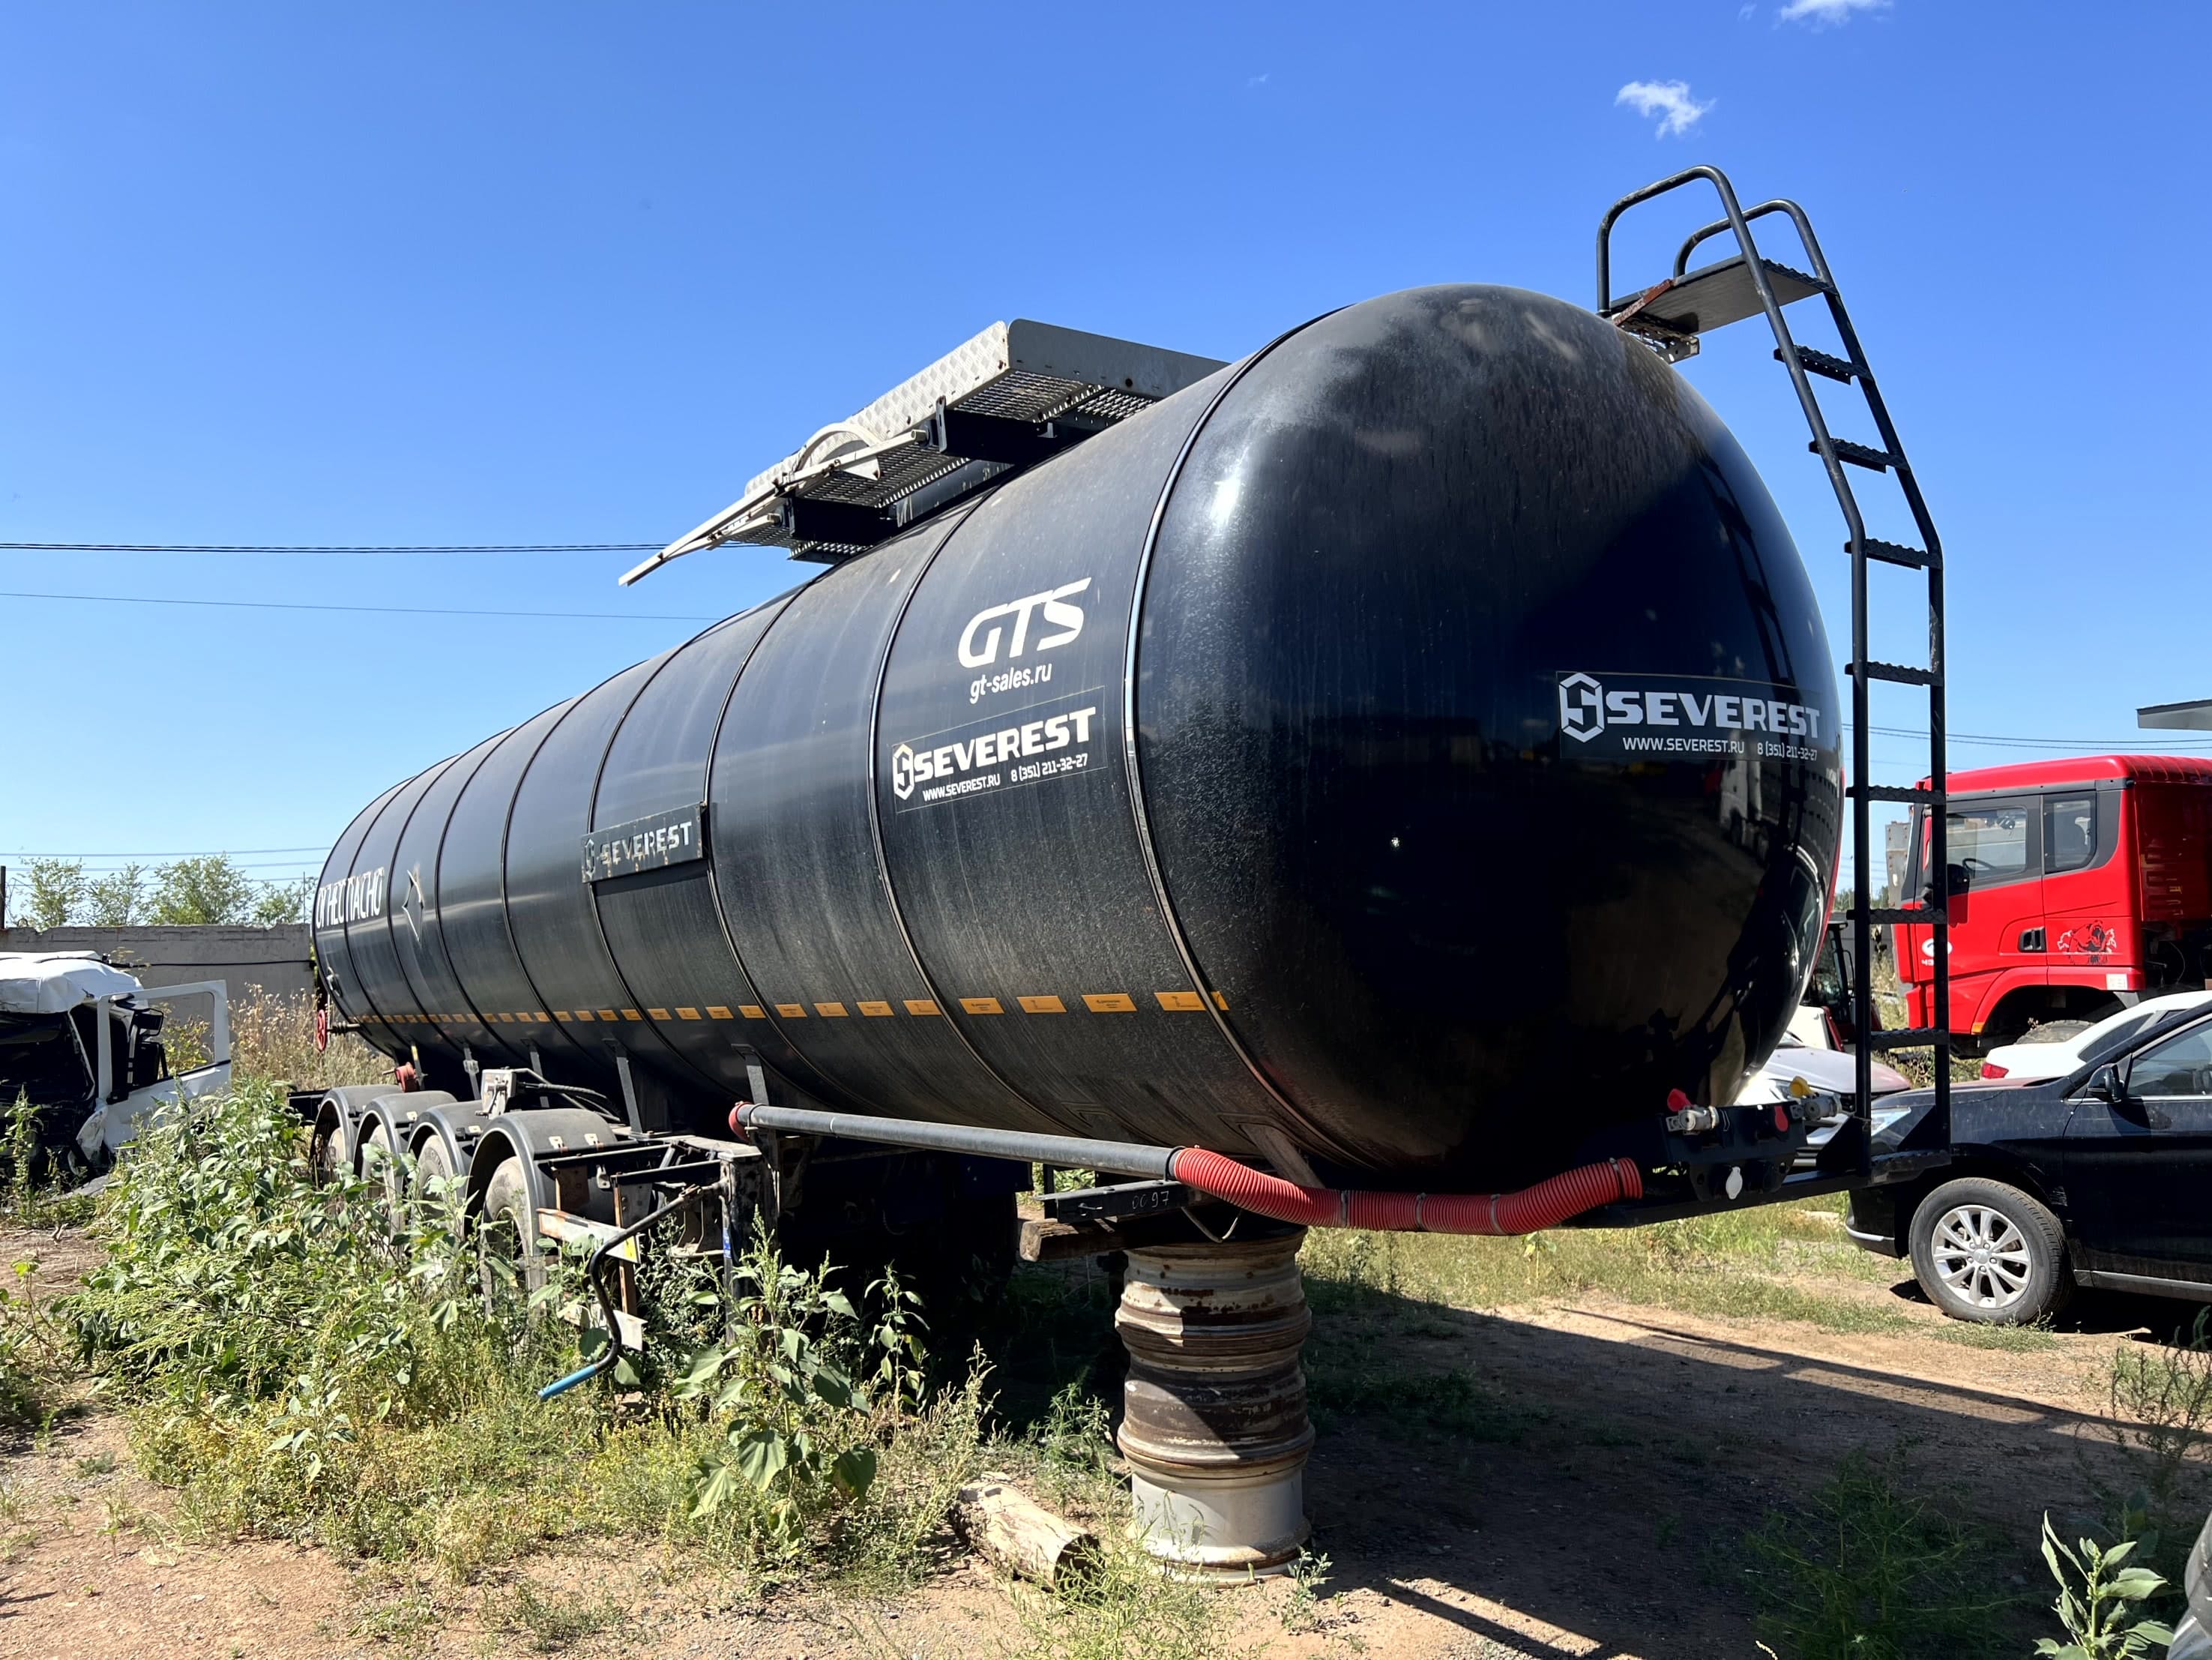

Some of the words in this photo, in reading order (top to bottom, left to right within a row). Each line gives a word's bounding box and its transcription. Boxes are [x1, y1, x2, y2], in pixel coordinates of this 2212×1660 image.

[958, 577, 1091, 668] GTS
[969, 664, 1052, 704] gt-sales.ru
[1606, 691, 1820, 739] SEVEREST
[914, 706, 1096, 783] SEVEREST
[1623, 737, 1744, 754] WWW.SEVEREST.RU
[1757, 743, 1763, 755] 8
[1765, 744, 1785, 759] (351)
[1787, 745, 1817, 761] 211-32-27
[923, 773, 1001, 802] WWW.SEVEREST.RU
[1011, 769, 1017, 782] 8
[1019, 763, 1040, 782] (351)
[1042, 753, 1088, 776] 211-32-27
[600, 821, 692, 865] SEVEREST
[316, 867, 384, 929] ОГНЕОПАСНО
